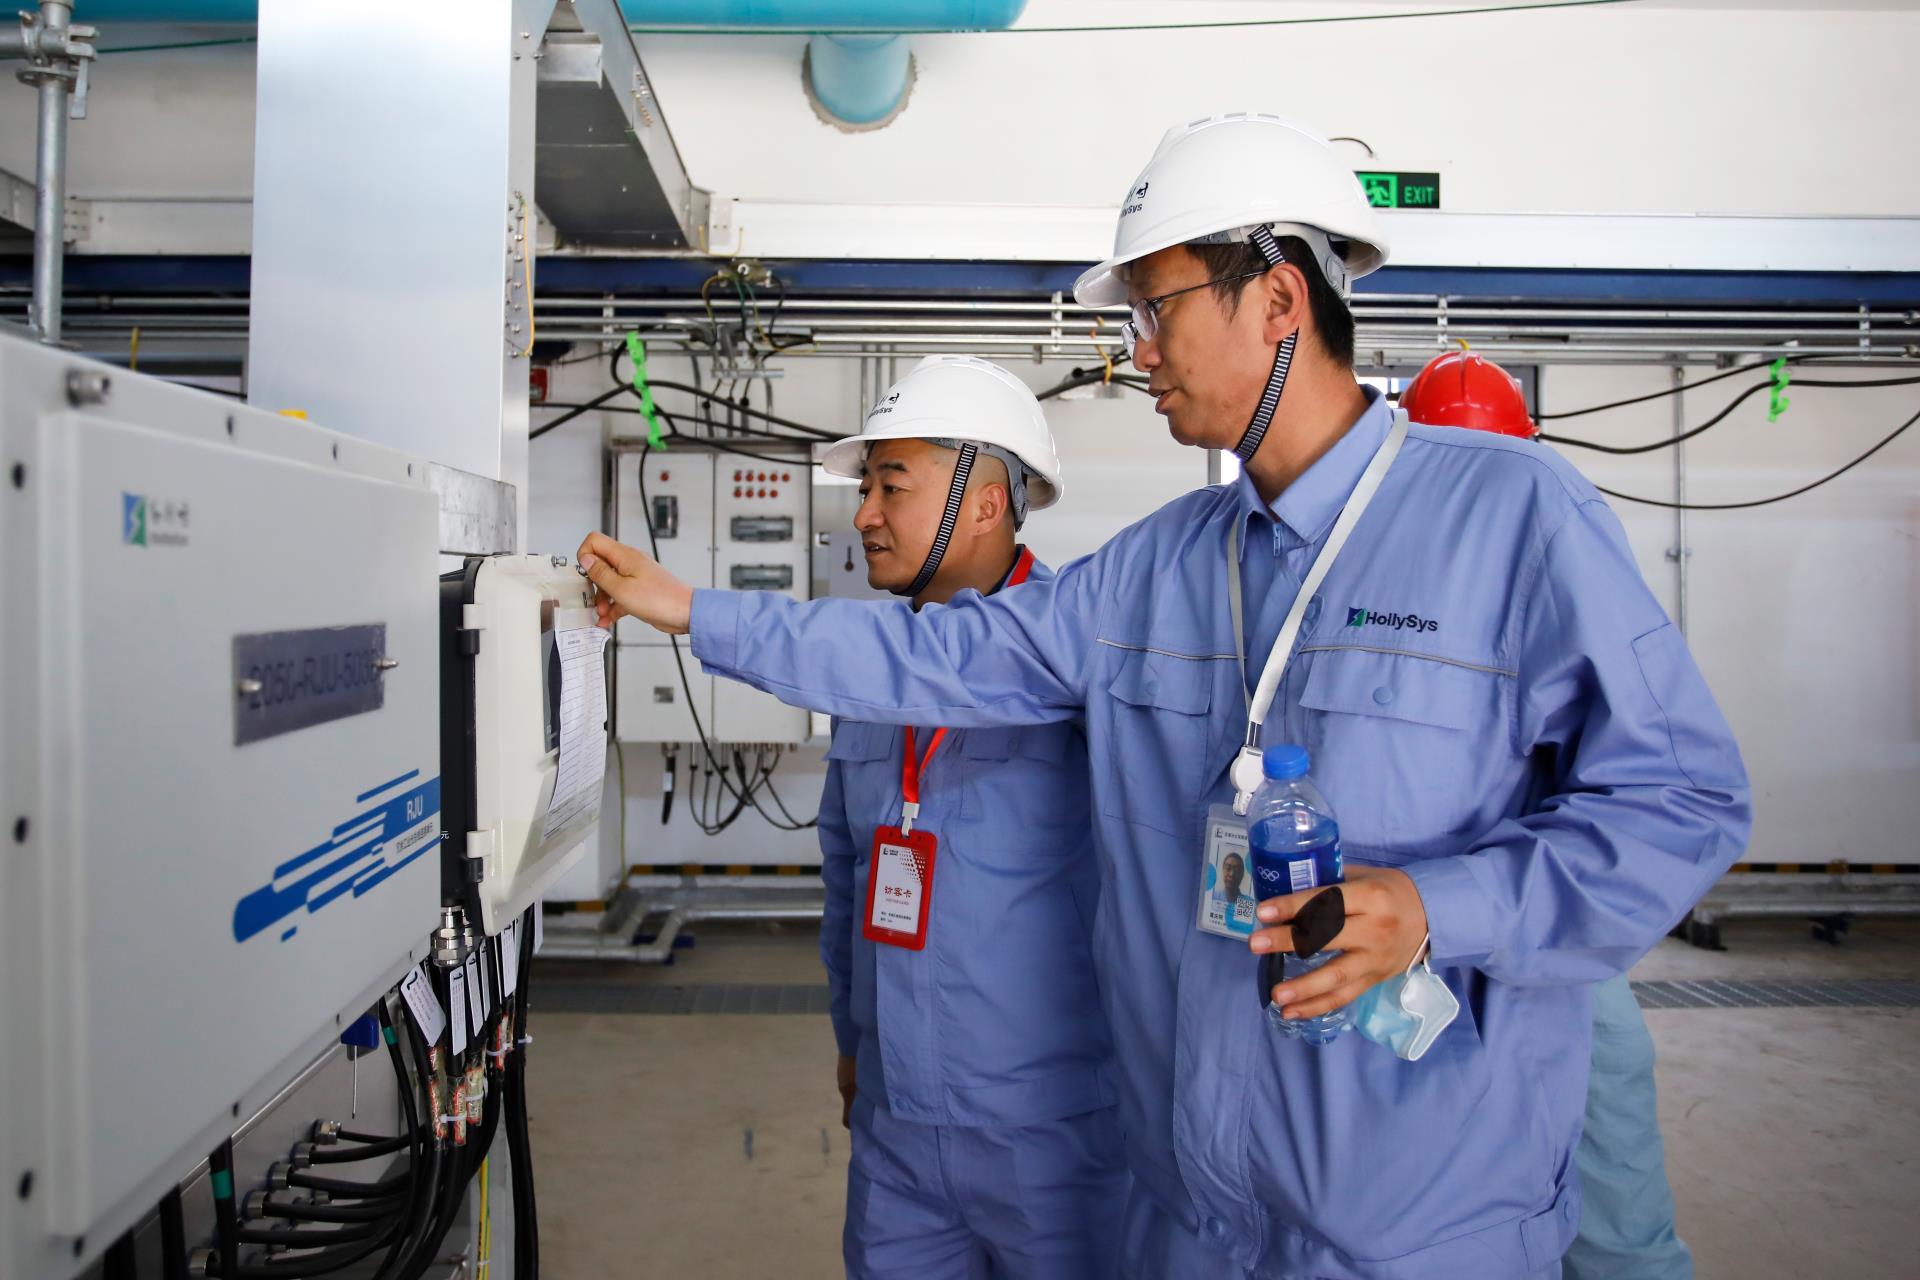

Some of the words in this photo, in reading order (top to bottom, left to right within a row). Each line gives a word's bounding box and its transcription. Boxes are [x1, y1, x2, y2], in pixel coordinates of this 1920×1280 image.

[1404, 186, 1434, 204] EXIT
[1365, 611, 1438, 633] HollySys
[407, 794, 424, 822] RJU
